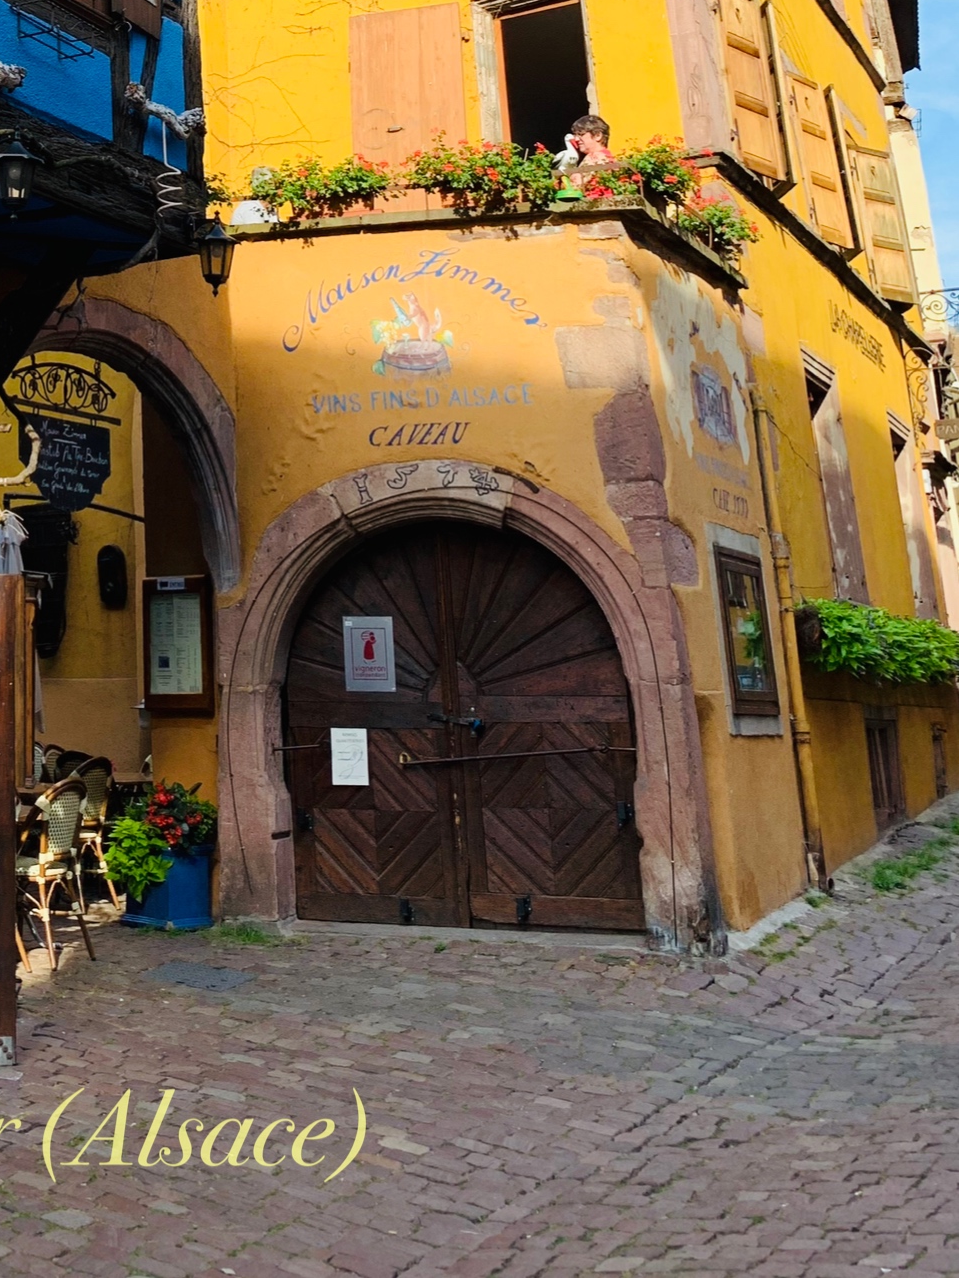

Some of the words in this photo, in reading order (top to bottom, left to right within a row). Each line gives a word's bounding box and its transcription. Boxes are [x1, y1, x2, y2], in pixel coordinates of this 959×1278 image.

[282, 263, 401, 353] Maison
[397, 246, 548, 328] Zimmer
[311, 394, 362, 414] VINS
[370, 389, 420, 410] FINS
[369, 421, 471, 447] CAVEAU
[354, 665, 387, 674] vigneron
